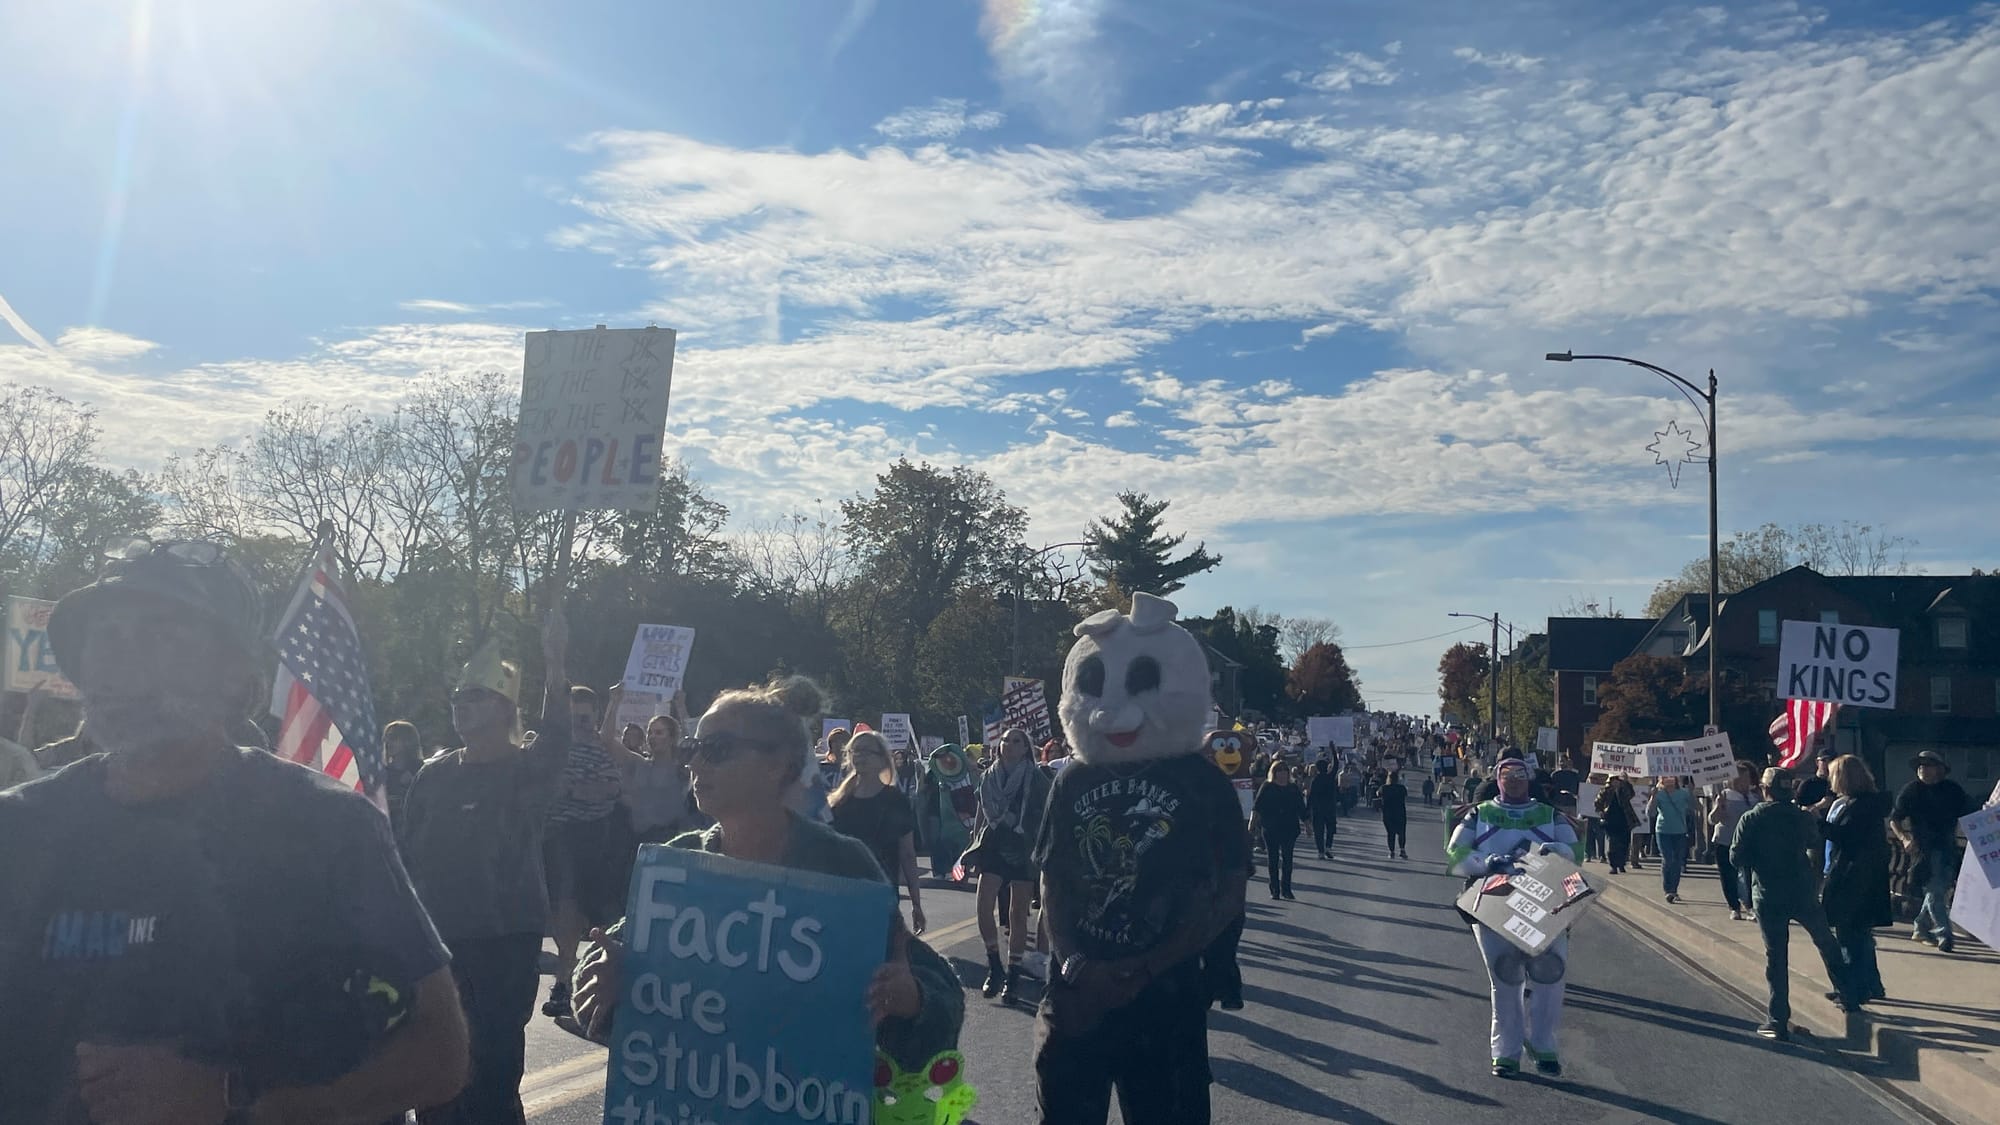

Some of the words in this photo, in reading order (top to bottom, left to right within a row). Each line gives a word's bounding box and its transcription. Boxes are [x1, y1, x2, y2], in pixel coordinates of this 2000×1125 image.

[570, 334, 607, 365] THE
[560, 368, 599, 398] THE
[567, 401, 608, 432] THE
[512, 433, 657, 486] PEOPLE
[1813, 626, 1870, 662] NO
[642, 655, 682, 673] GIRLS
[1788, 663, 1892, 703] KINGS
[1597, 744, 1615, 752] RULE
[1616, 746, 1626, 754] OF
[1610, 754, 1626, 762] NOT
[1656, 756, 1688, 765] BETTE
[1594, 762, 1612, 771] RULE
[1623, 765, 1642, 774] KING
[1127, 778, 1183, 813] BANKS
[1514, 875, 1551, 901] SWEAR
[1515, 897, 1539, 918] HER
[632, 866, 823, 983] Facts
[1512, 921, 1537, 941] IN!
[631, 972, 727, 1035] are
